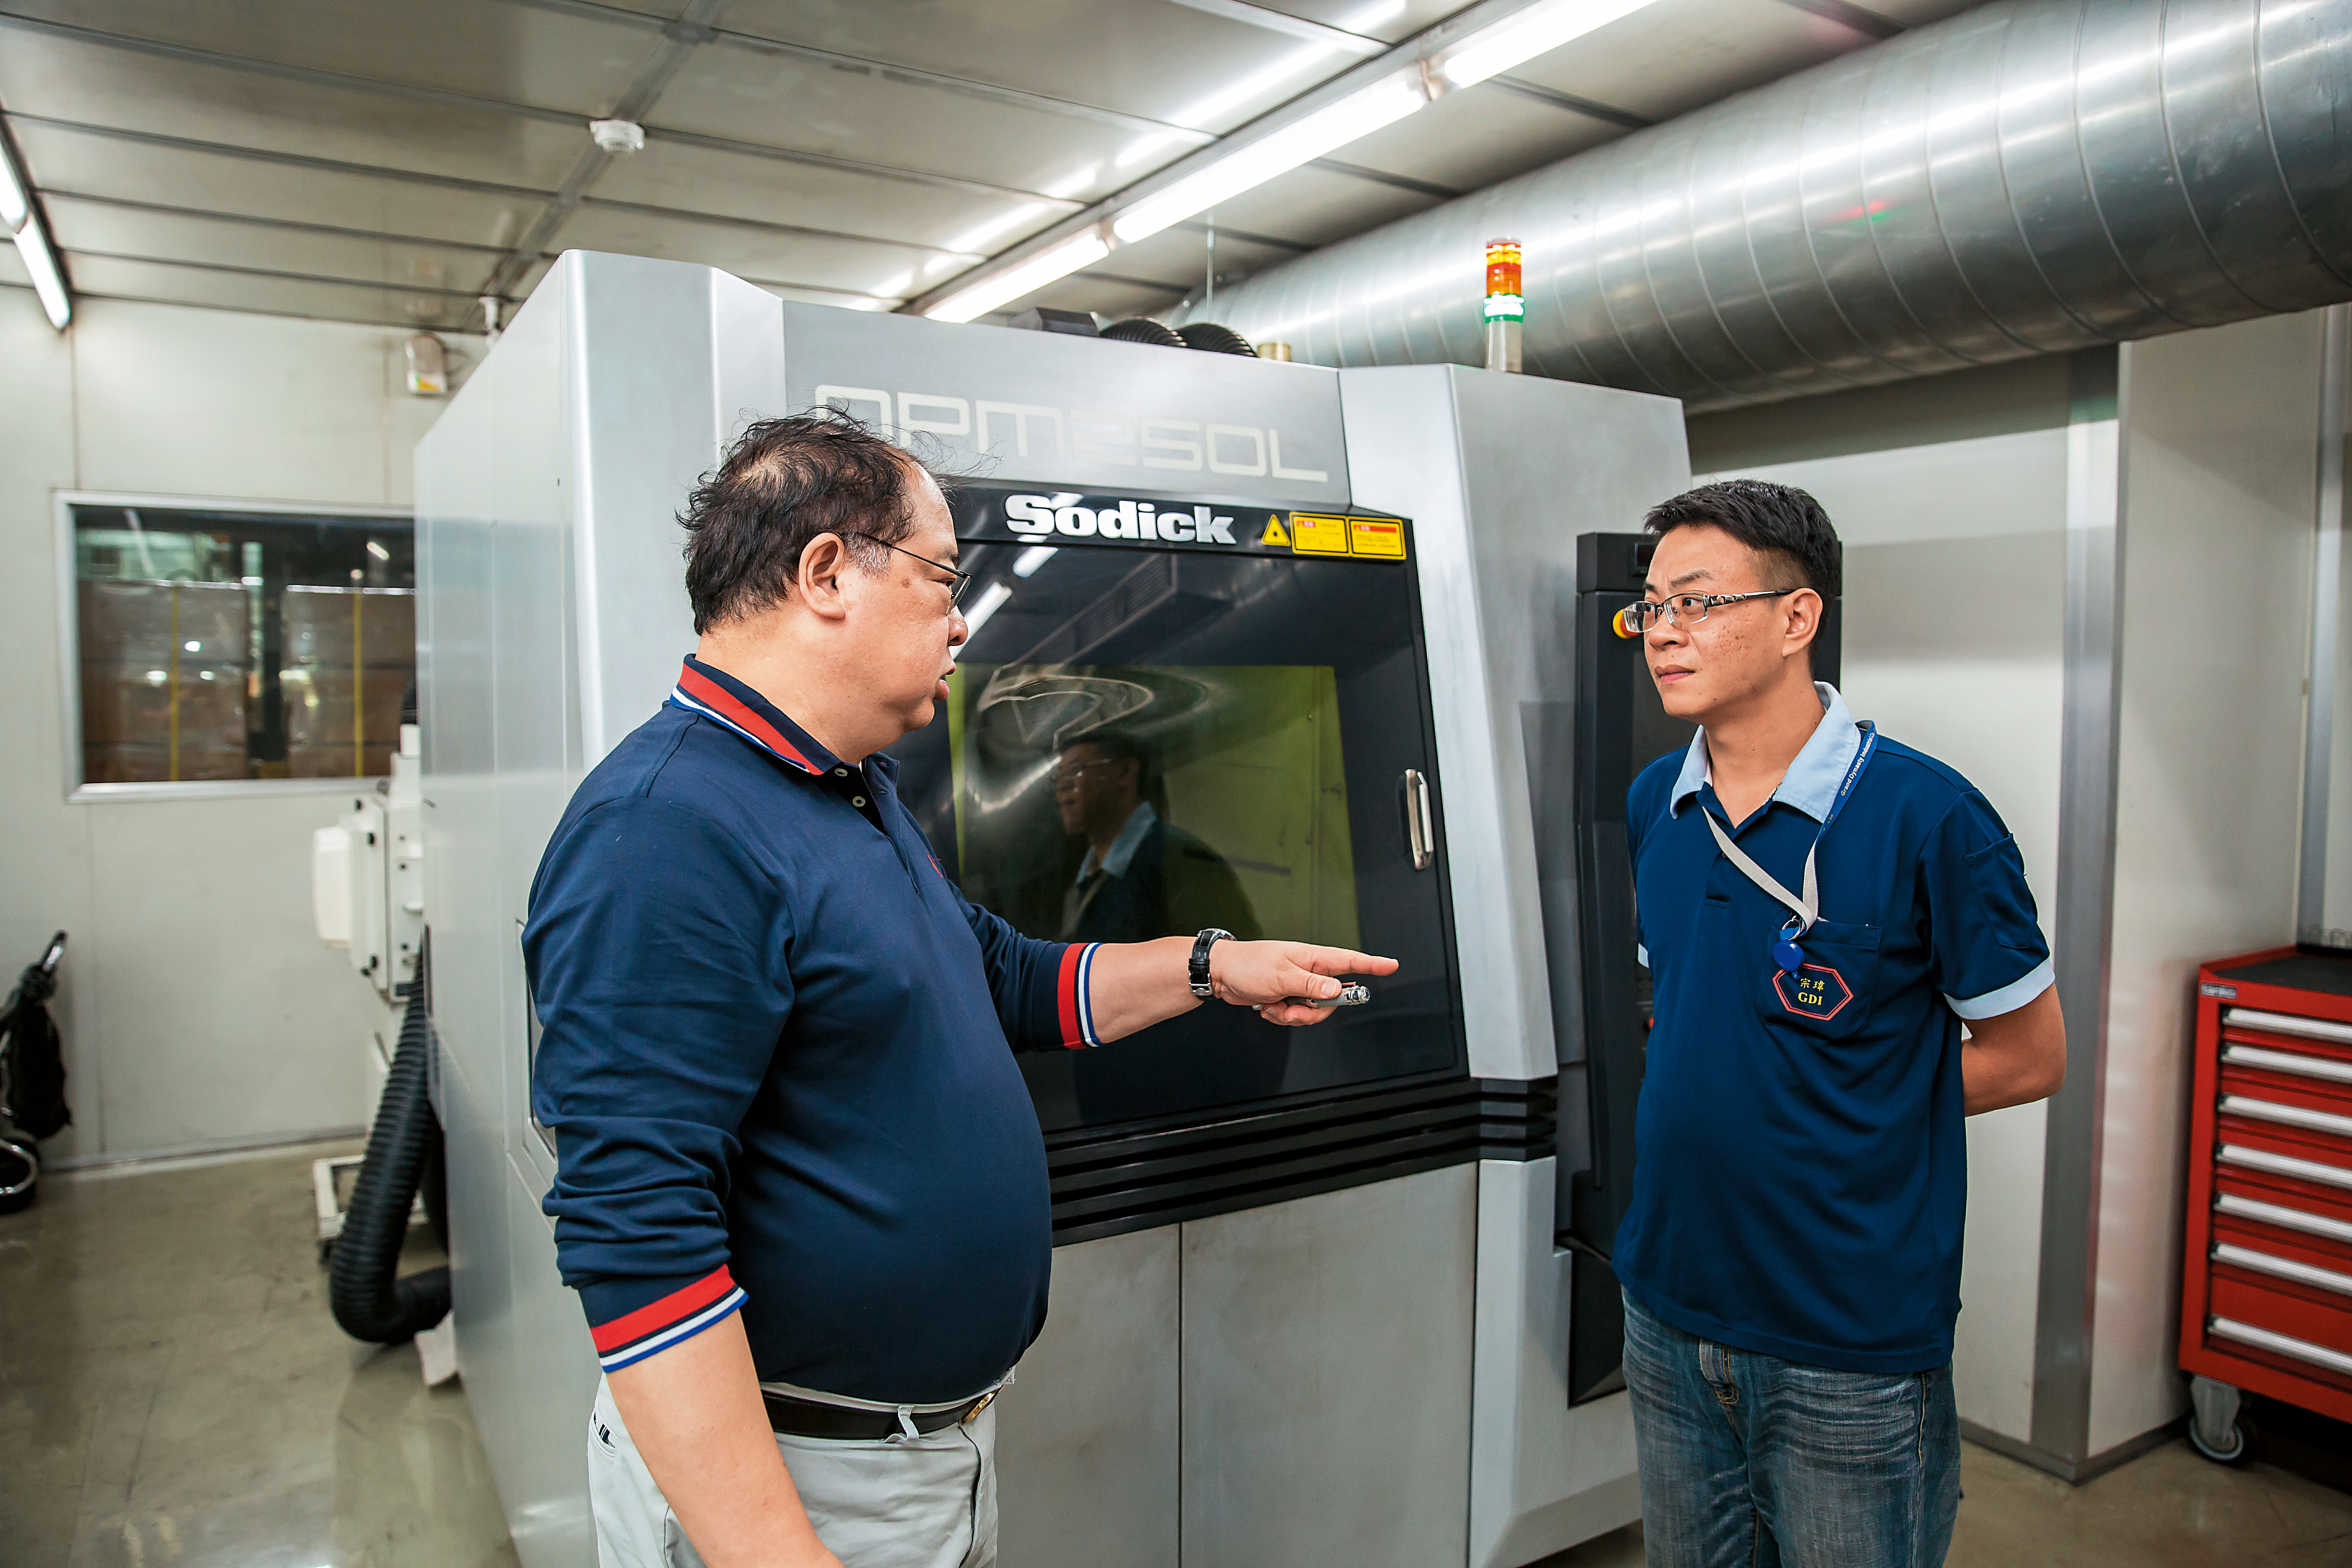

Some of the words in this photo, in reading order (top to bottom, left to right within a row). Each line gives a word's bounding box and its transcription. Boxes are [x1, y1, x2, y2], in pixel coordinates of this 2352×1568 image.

[1005, 494, 1237, 545] Sodick
[1841, 778, 1852, 796] Grand
[1849, 757, 1864, 779] Dynasty
[1798, 992, 1822, 1005] GDI
